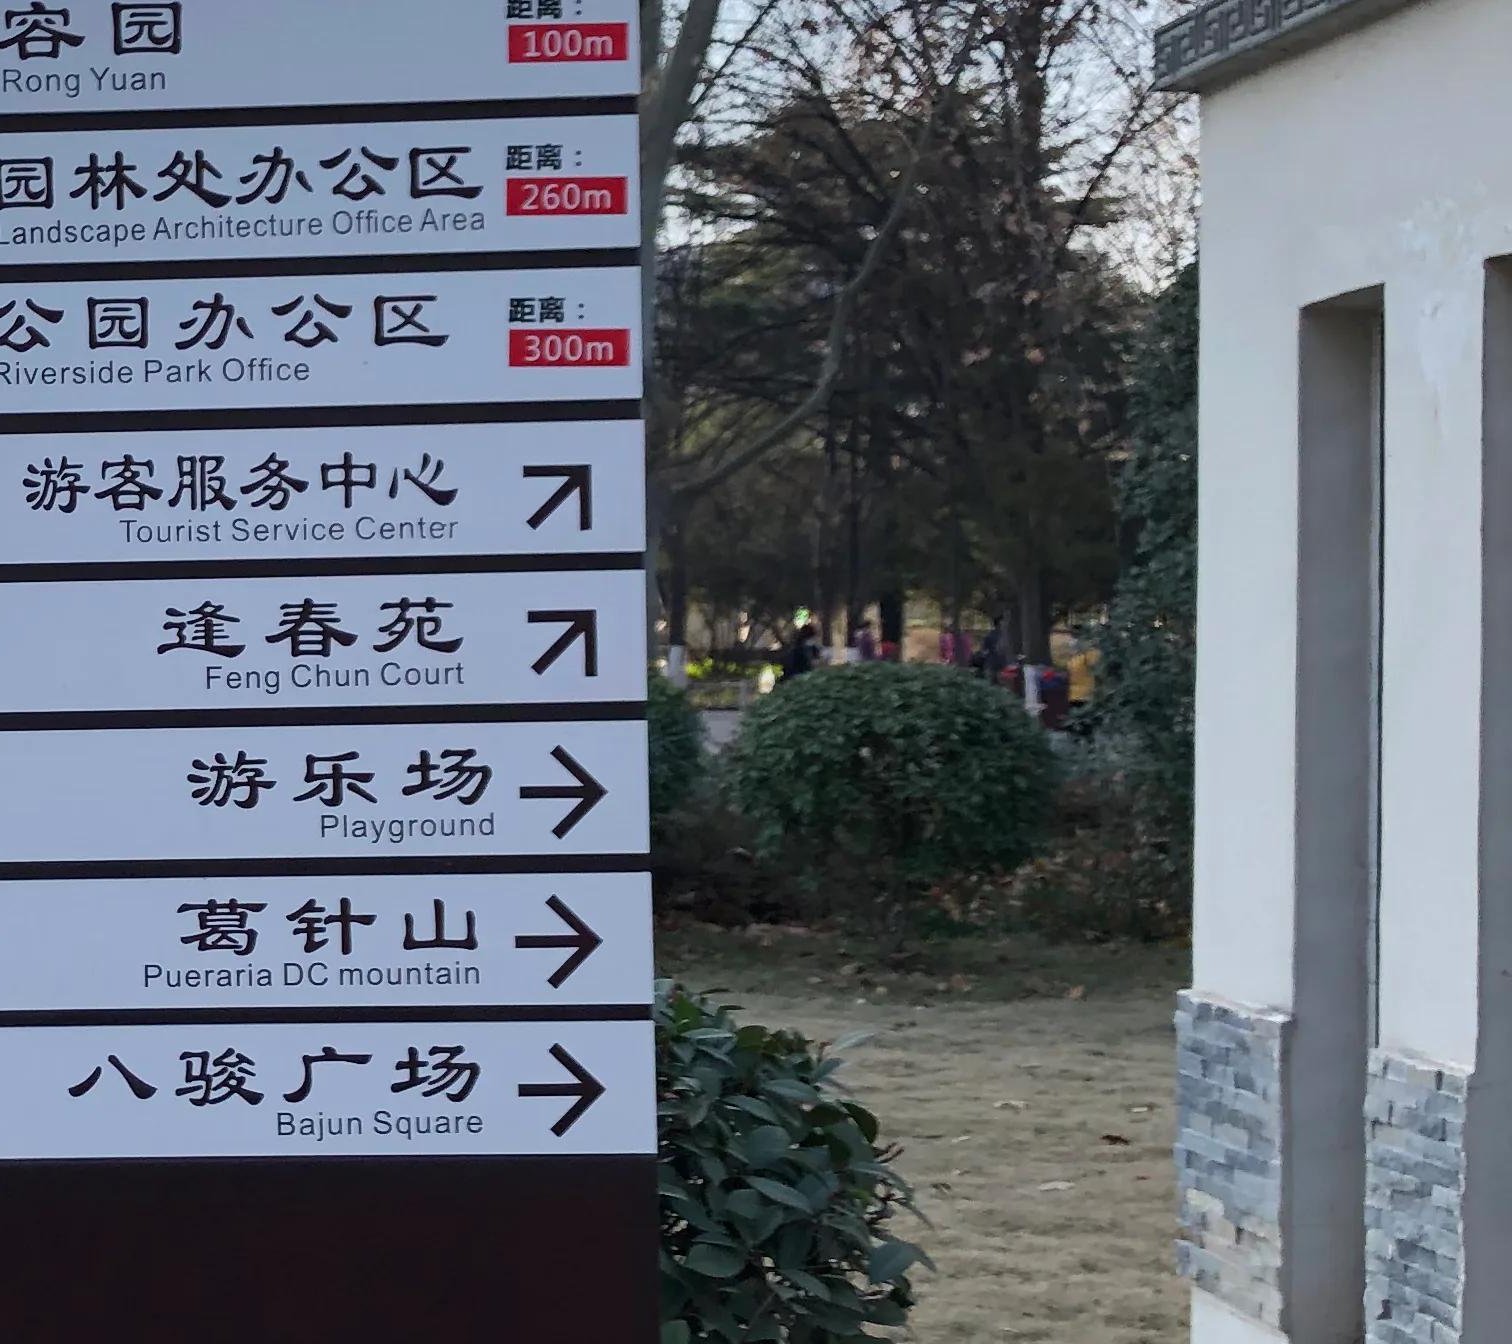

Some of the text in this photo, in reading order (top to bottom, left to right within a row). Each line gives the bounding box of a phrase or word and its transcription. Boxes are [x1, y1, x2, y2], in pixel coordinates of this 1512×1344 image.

[522, 28, 615, 58] 100m
[2, 66, 166, 99] Rong Yuan
[521, 182, 612, 211] 260m
[152, 212, 323, 243] Architecture
[332, 209, 413, 235] Office
[420, 208, 485, 232] Area
[524, 334, 615, 364] 300m
[144, 358, 212, 383] Park
[222, 357, 310, 382] Office
[22, 451, 459, 514] 游客服务中心
[119, 516, 459, 543] Tourist Service Center
[156, 596, 464, 659] 逢春苑
[206, 661, 465, 695] Feng Chun Court
[186, 748, 493, 810] 游乐场
[320, 812, 495, 844] Playground
[176, 896, 479, 957] 葛针山
[144, 960, 480, 988] Pueraria DC mountain
[67, 1044, 481, 1107] 八骏广场
[276, 1110, 483, 1142] Bajun Square
